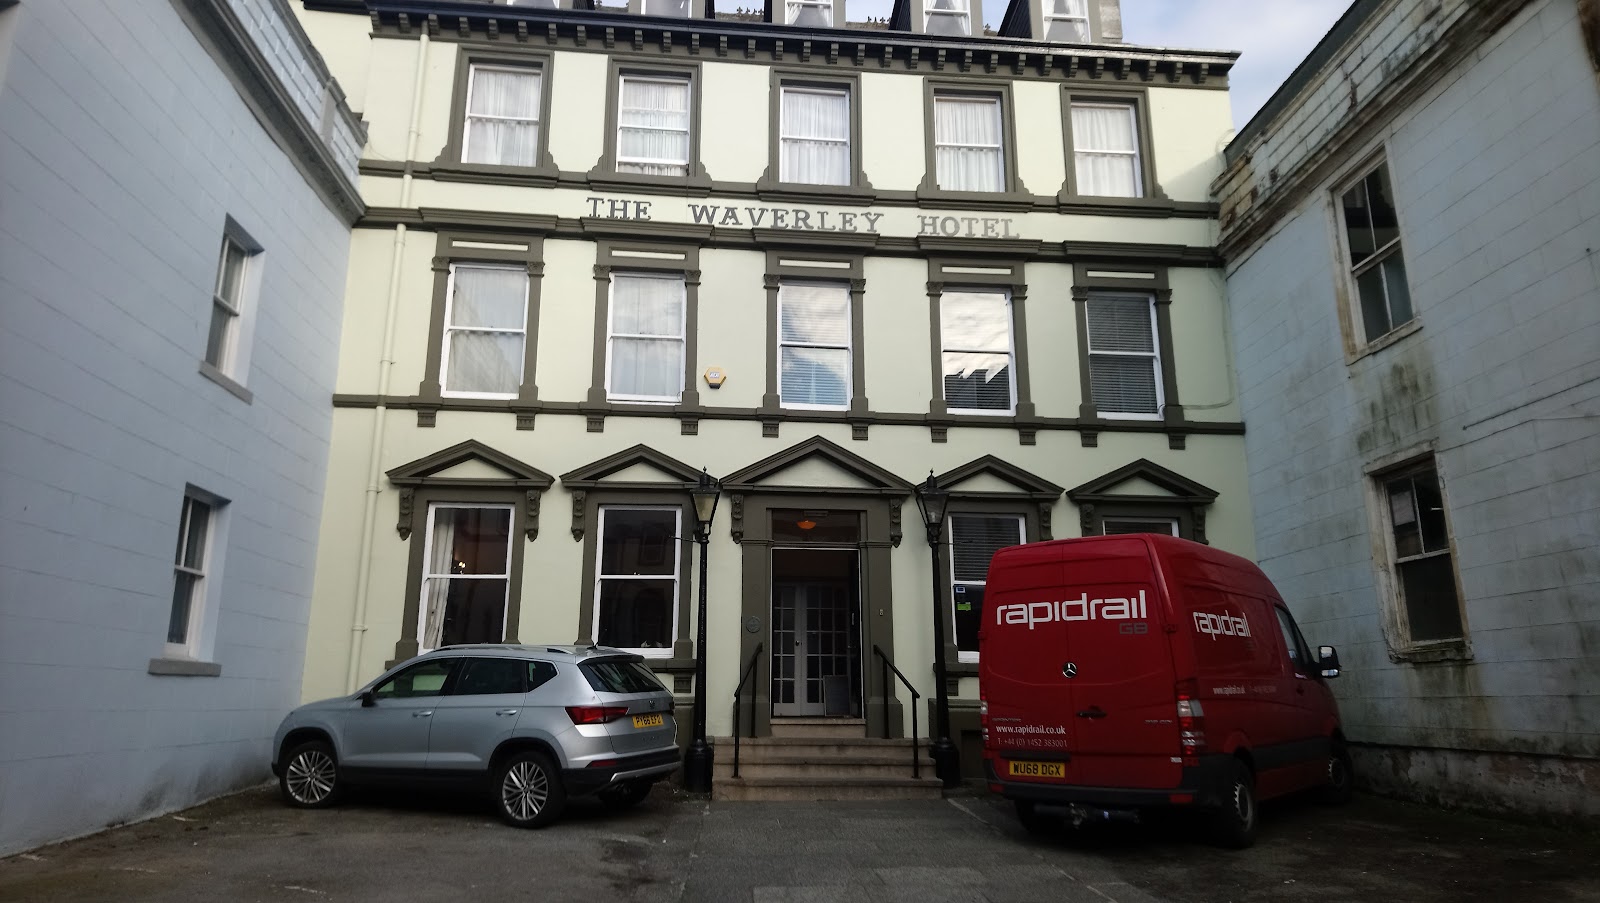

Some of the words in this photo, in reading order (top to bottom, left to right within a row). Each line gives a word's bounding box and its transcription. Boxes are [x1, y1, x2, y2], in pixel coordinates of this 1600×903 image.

[586, 197, 652, 221] THE
[687, 203, 885, 234] WAVERLEY
[917, 214, 1021, 240] HOTEL
[996, 589, 1148, 630] rapidrail
[1118, 622, 1149, 635] GB
[1192, 609, 1252, 641] rapidrail
[996, 724, 1066, 735] www.rapidrail.co.uk
[1013, 762, 1039, 774] WU68
[1041, 764, 1061, 776] DGX
